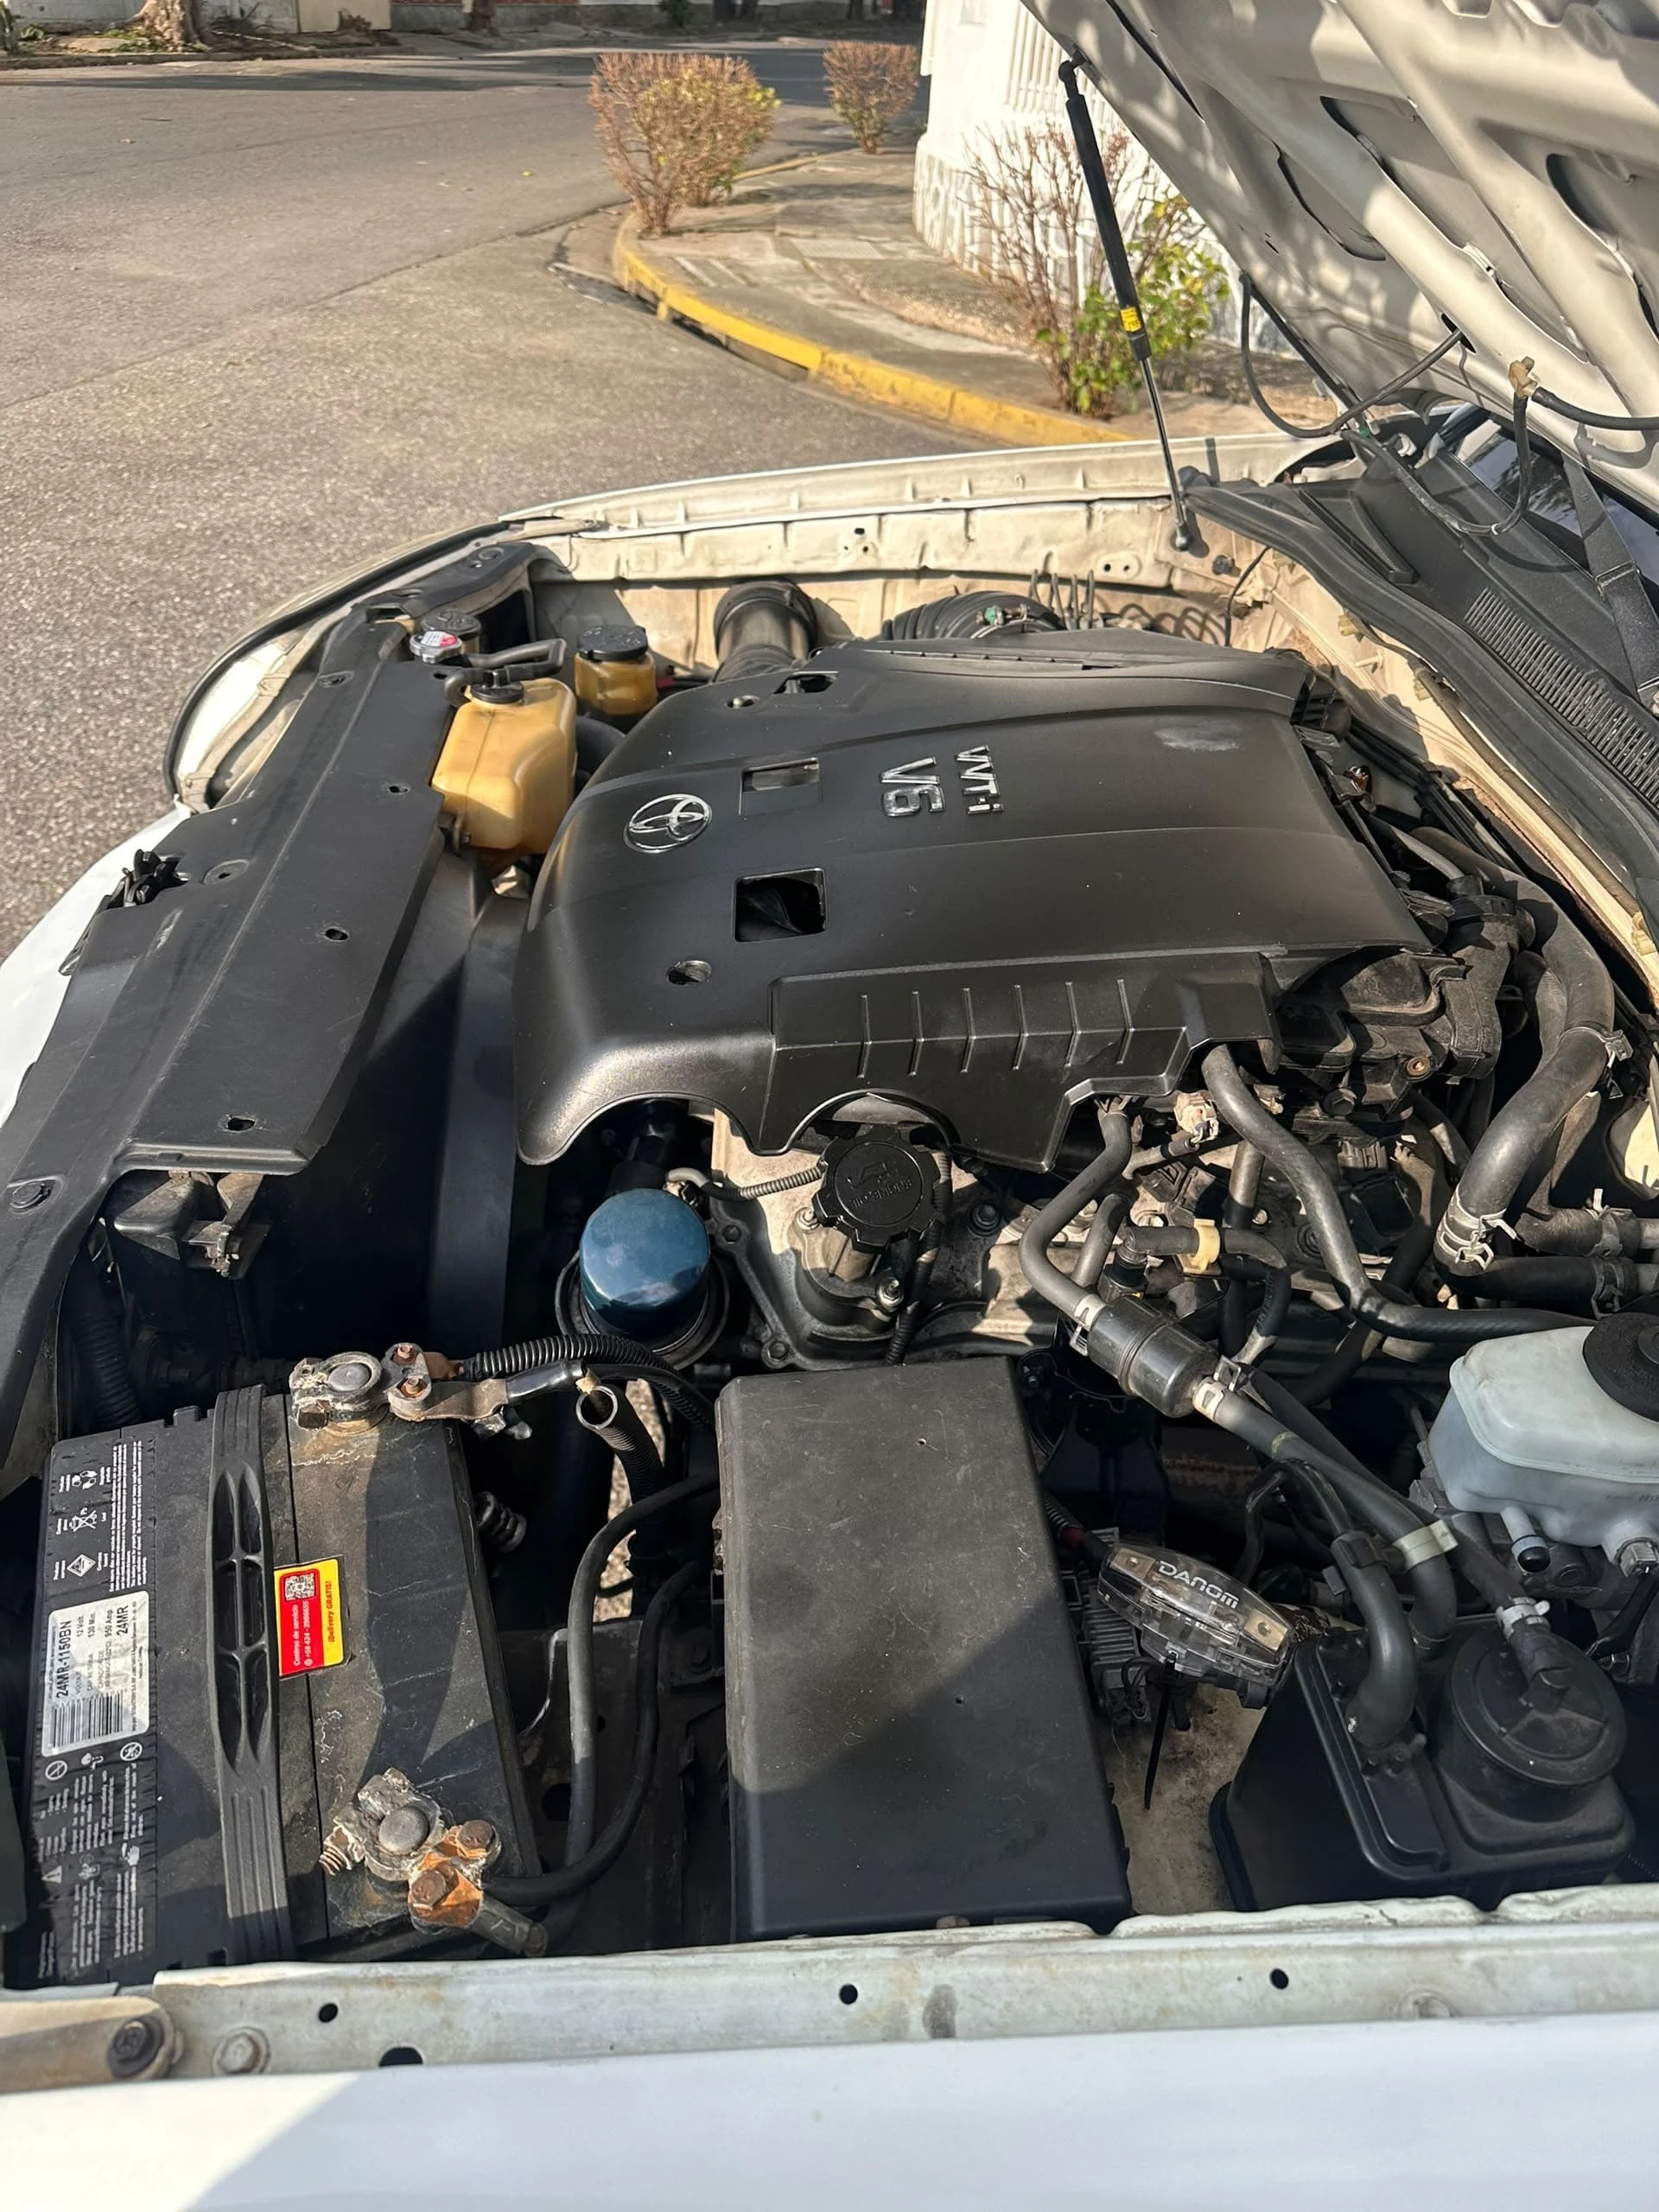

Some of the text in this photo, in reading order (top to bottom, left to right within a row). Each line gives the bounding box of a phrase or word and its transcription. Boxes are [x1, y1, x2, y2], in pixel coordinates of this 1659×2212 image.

[880, 758, 945, 817] V6
[325, 1581, 334, 1609] GRATIS!
[117, 1605, 129, 1635] 24MR
[56, 1620, 72, 1698] 24MR-1150BN
